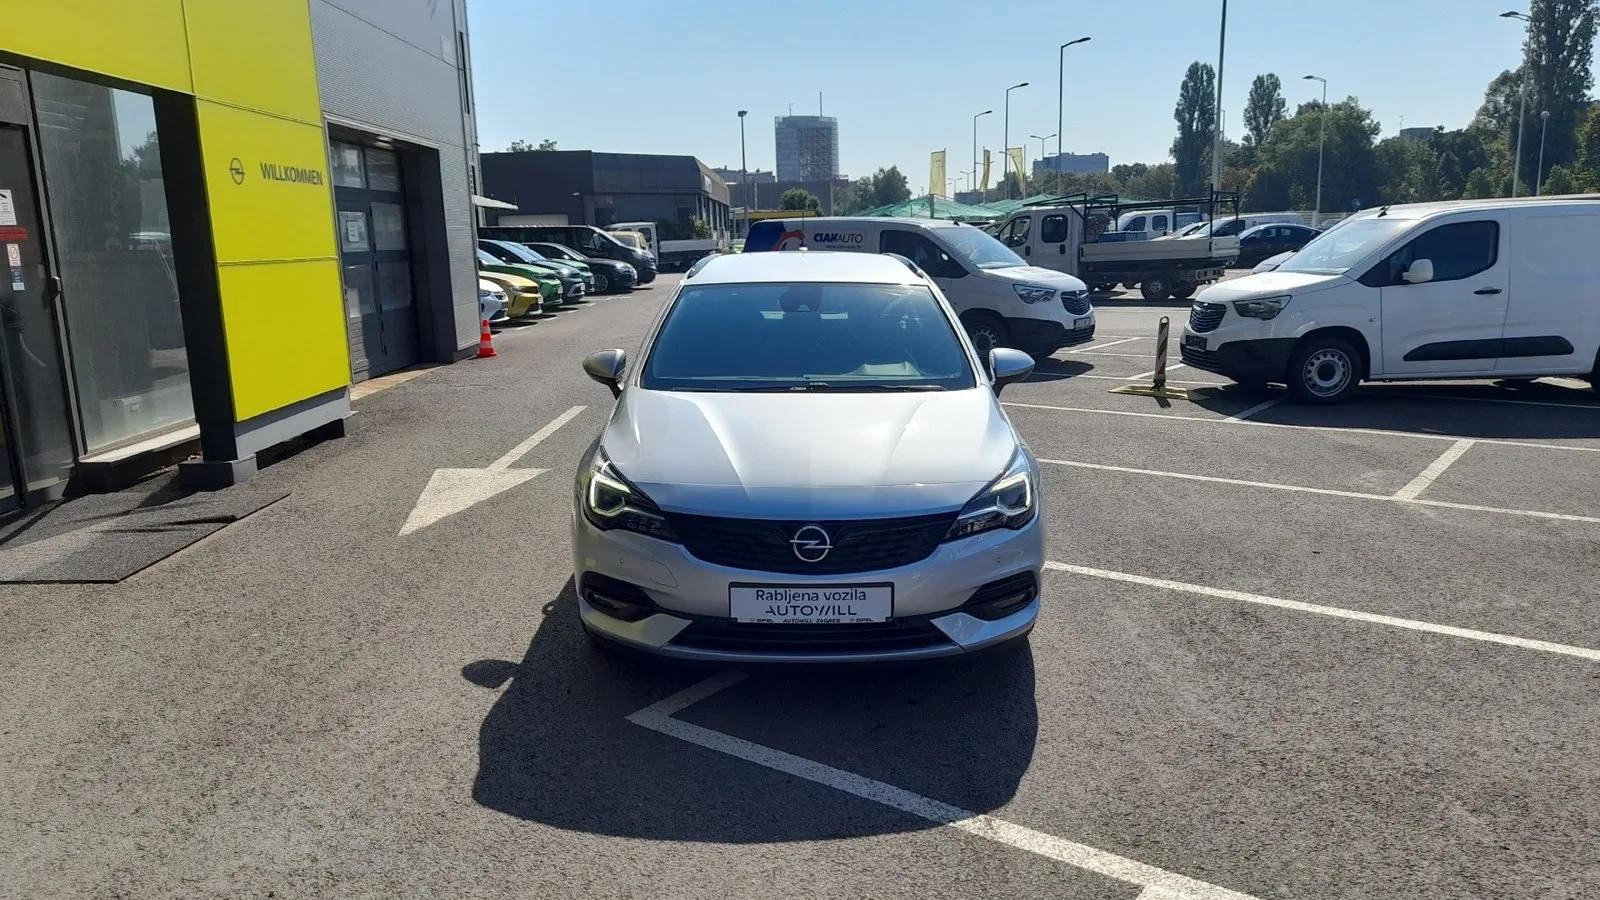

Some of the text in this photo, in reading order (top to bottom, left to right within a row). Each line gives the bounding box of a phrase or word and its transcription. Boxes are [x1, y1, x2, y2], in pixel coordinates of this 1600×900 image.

[260, 162, 323, 186] WILLKOMMEN
[756, 589, 867, 604] Rabljena vozila
